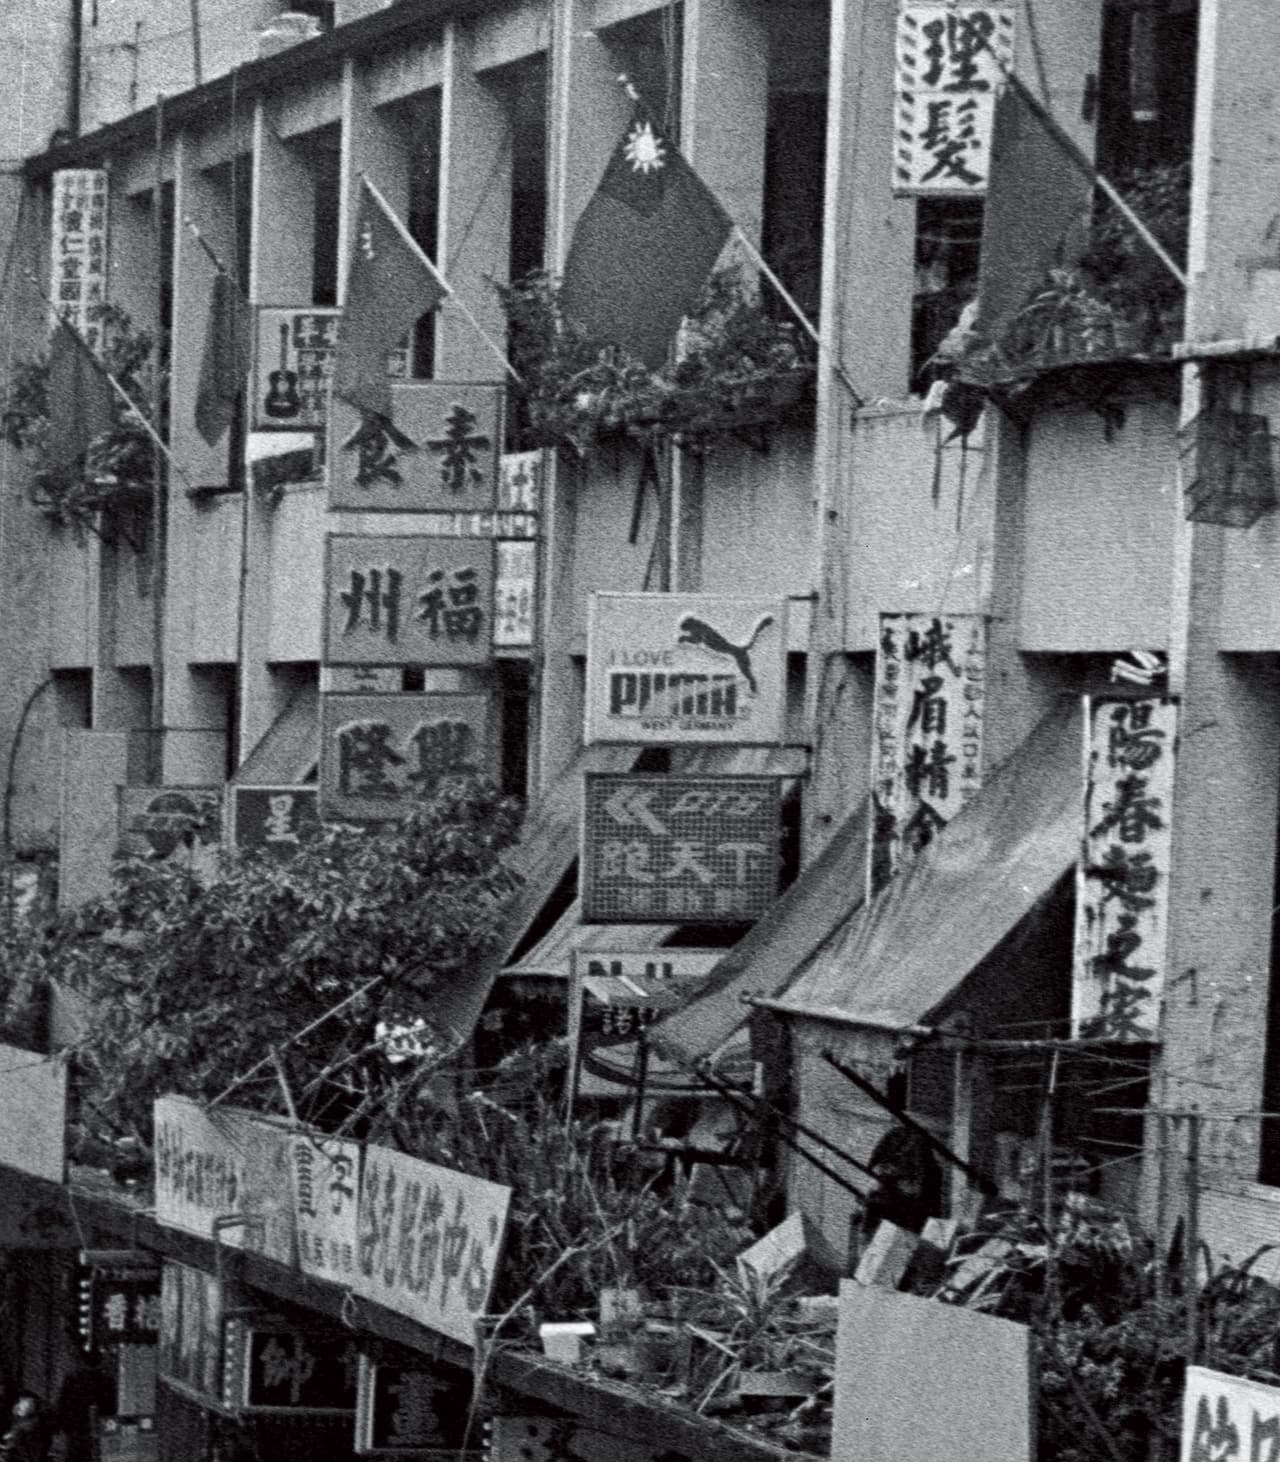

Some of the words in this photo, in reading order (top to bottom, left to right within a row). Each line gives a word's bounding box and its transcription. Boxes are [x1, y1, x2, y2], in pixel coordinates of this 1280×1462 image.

[341, 404, 489, 491] 素食
[341, 568, 483, 643] 福州
[622, 650, 675, 666] LOVE
[641, 720, 672, 730] WEST
